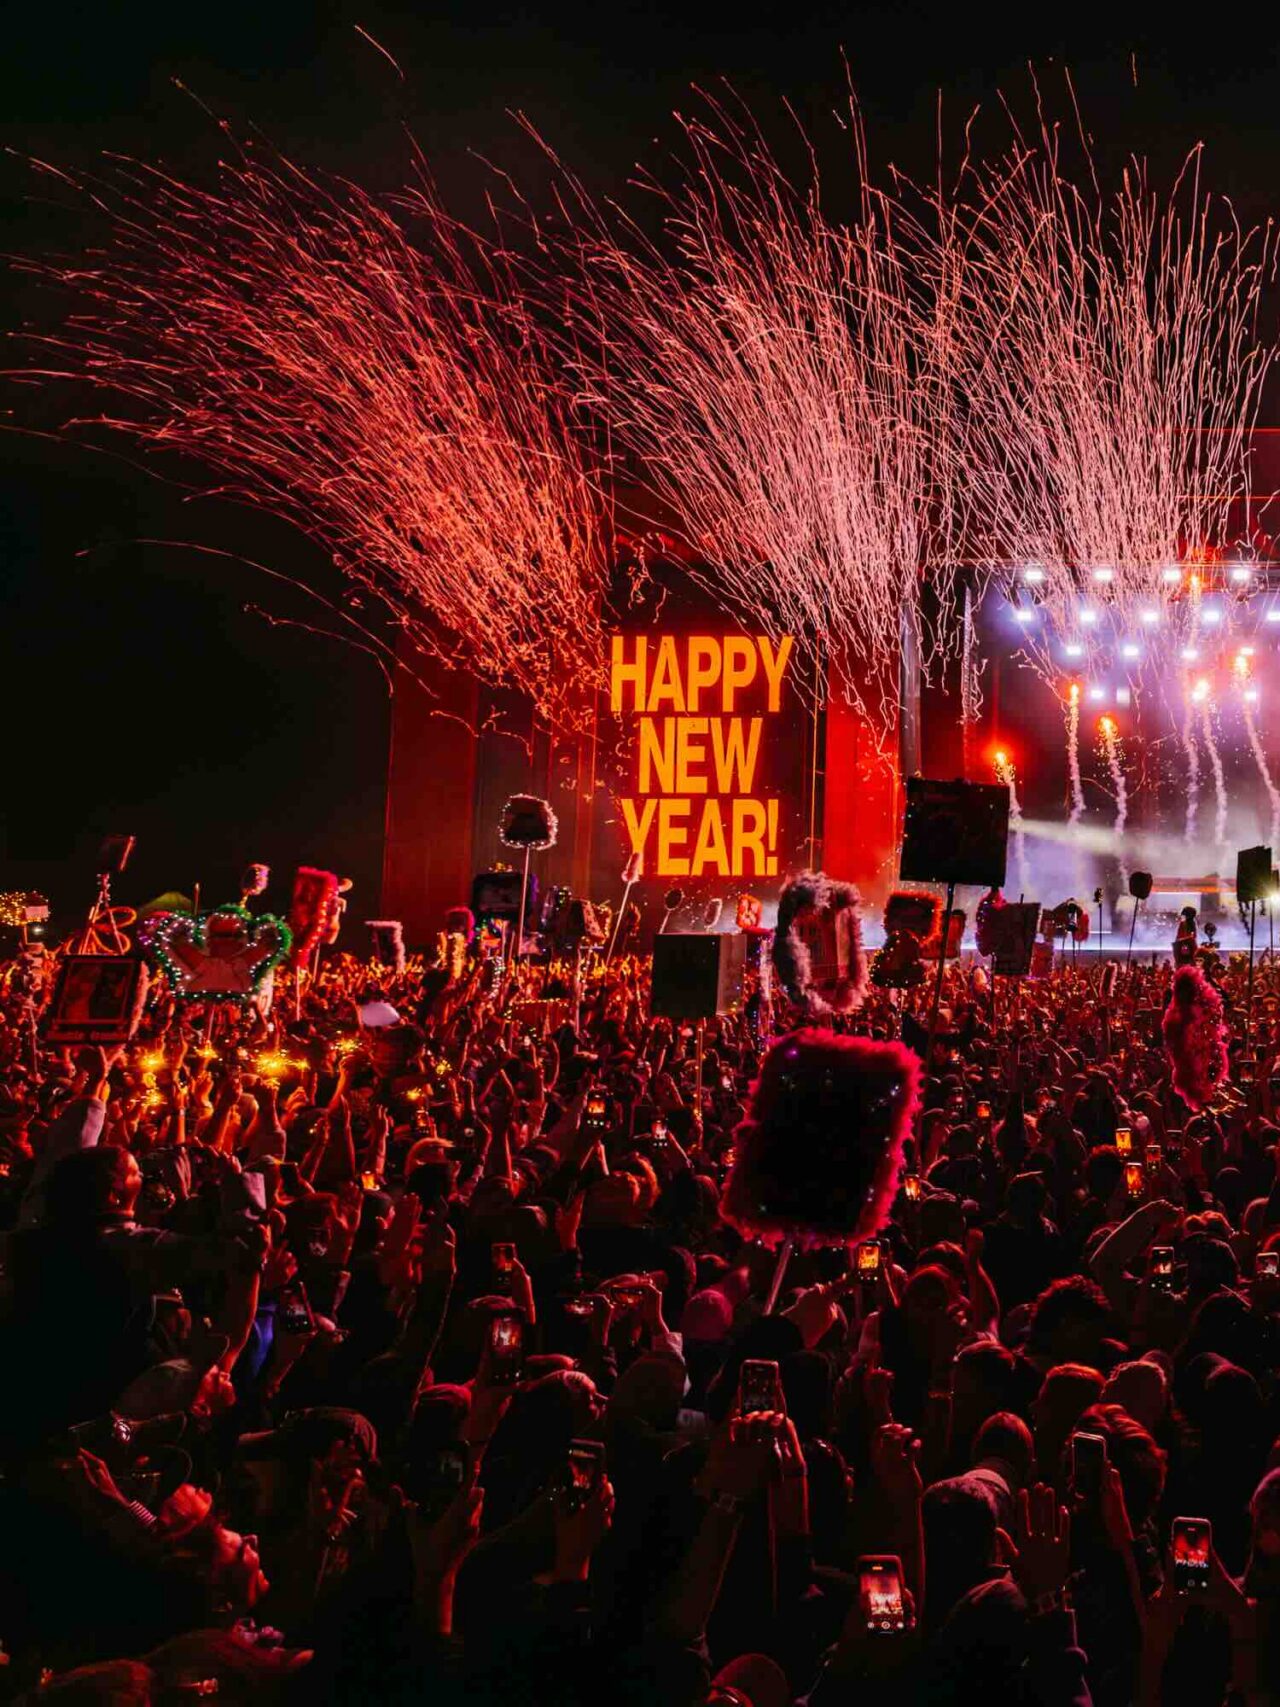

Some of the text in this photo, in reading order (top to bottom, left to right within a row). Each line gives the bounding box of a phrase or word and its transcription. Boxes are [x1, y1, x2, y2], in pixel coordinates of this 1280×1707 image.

[610, 635, 794, 713] HAPPY
[638, 717, 763, 794] NEW
[621, 798, 779, 876] YEAR!
